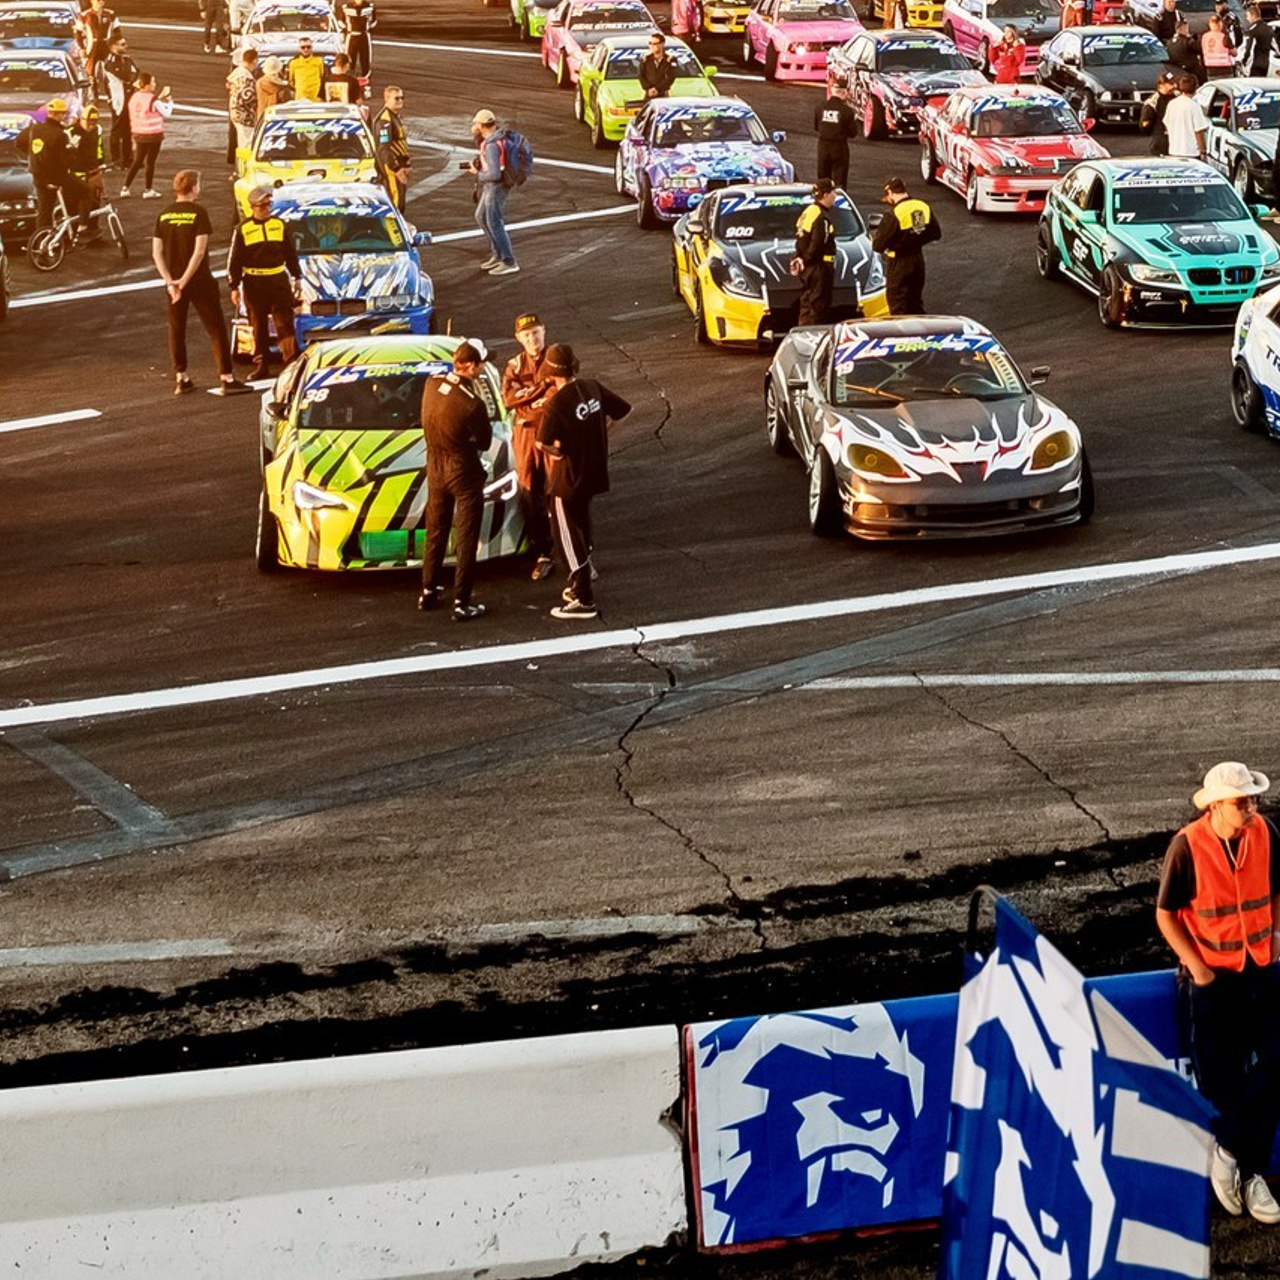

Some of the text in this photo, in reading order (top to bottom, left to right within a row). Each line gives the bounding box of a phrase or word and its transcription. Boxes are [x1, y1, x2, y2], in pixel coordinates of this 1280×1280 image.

[822, 110, 840, 124] ICE
[725, 226, 755, 238] 900
[835, 361, 855, 376] 19
[304, 388, 330, 404] 38
